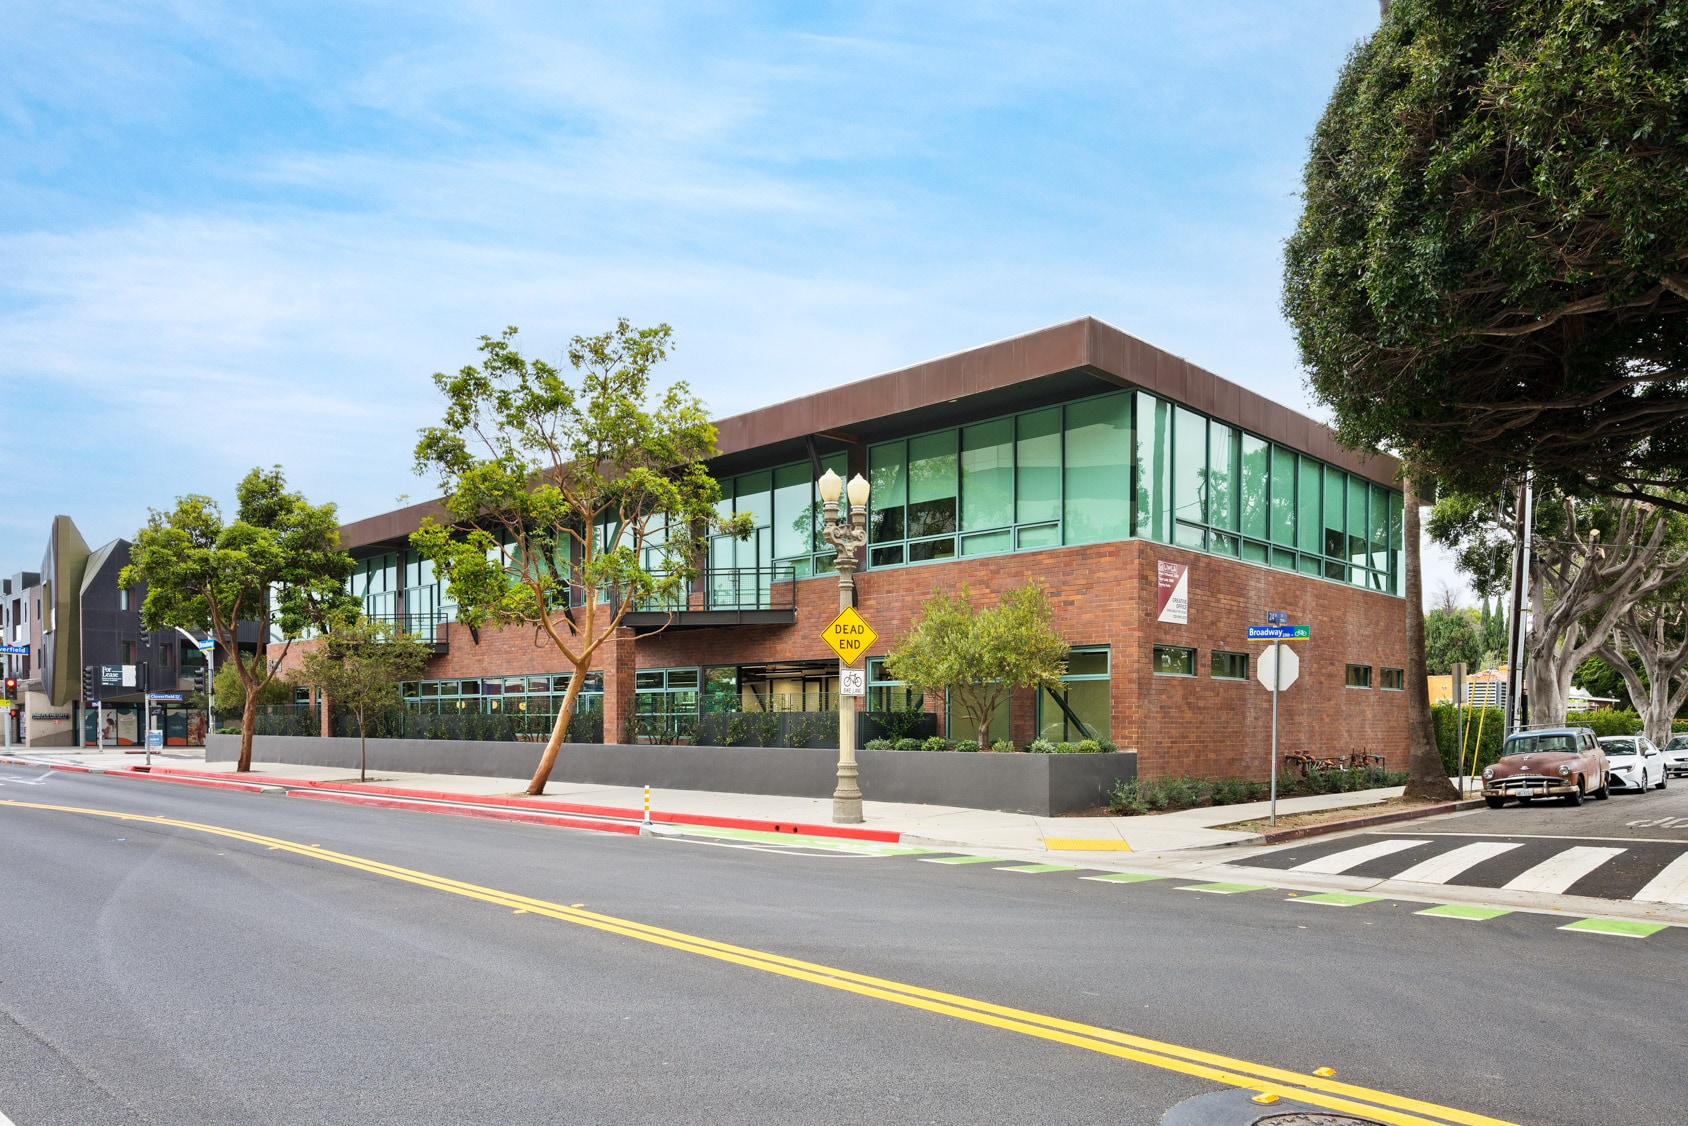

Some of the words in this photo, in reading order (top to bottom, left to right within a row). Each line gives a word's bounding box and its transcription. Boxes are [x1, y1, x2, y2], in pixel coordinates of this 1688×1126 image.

[835, 624, 864, 634] DEAD
[1249, 628, 1283, 637] Broadway
[840, 640, 860, 649] END
